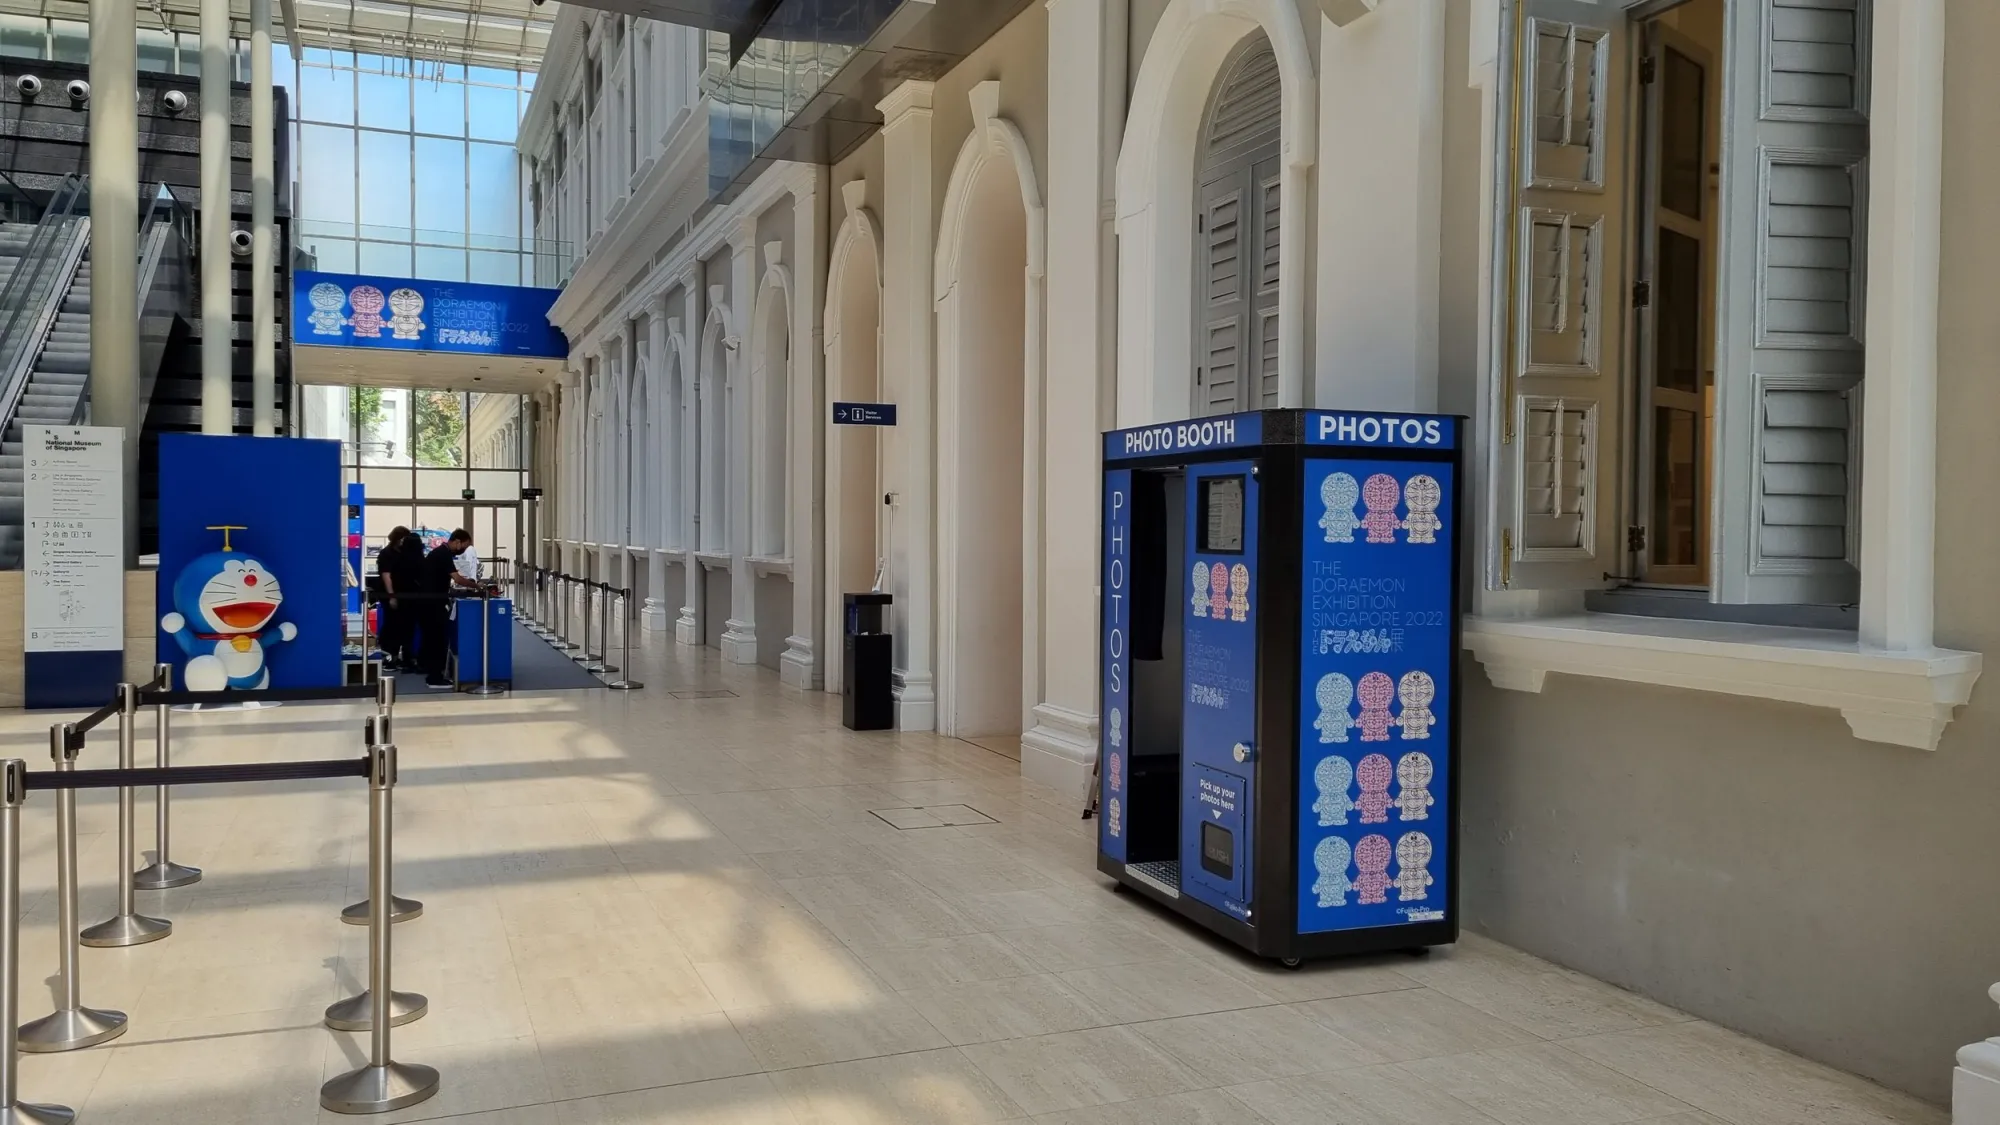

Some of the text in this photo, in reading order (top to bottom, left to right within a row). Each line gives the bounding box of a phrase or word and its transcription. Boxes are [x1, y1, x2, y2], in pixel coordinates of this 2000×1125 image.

[432, 288, 455, 298] THE
[433, 298, 500, 310] DORAEMON
[433, 308, 495, 320] EXHIBITION
[433, 318, 529, 333] SINGAPORE 2022
[1126, 419, 1235, 453] PHOTO BOOTH
[1320, 415, 1441, 444] PHOTOS
[1313, 561, 1341, 575] THE
[1110, 491, 1123, 693] PHOTOS
[1313, 578, 1405, 592] DORAEMON
[1313, 595, 1396, 610] EXHIBITION
[1313, 611, 1443, 626] SINGAPORE 2022
[1189, 629, 1202, 643] THE
[1230, 677, 1250, 693] 2022
[1200, 779, 1235, 799] Pick up your
[1200, 792, 1234, 811] photos here
